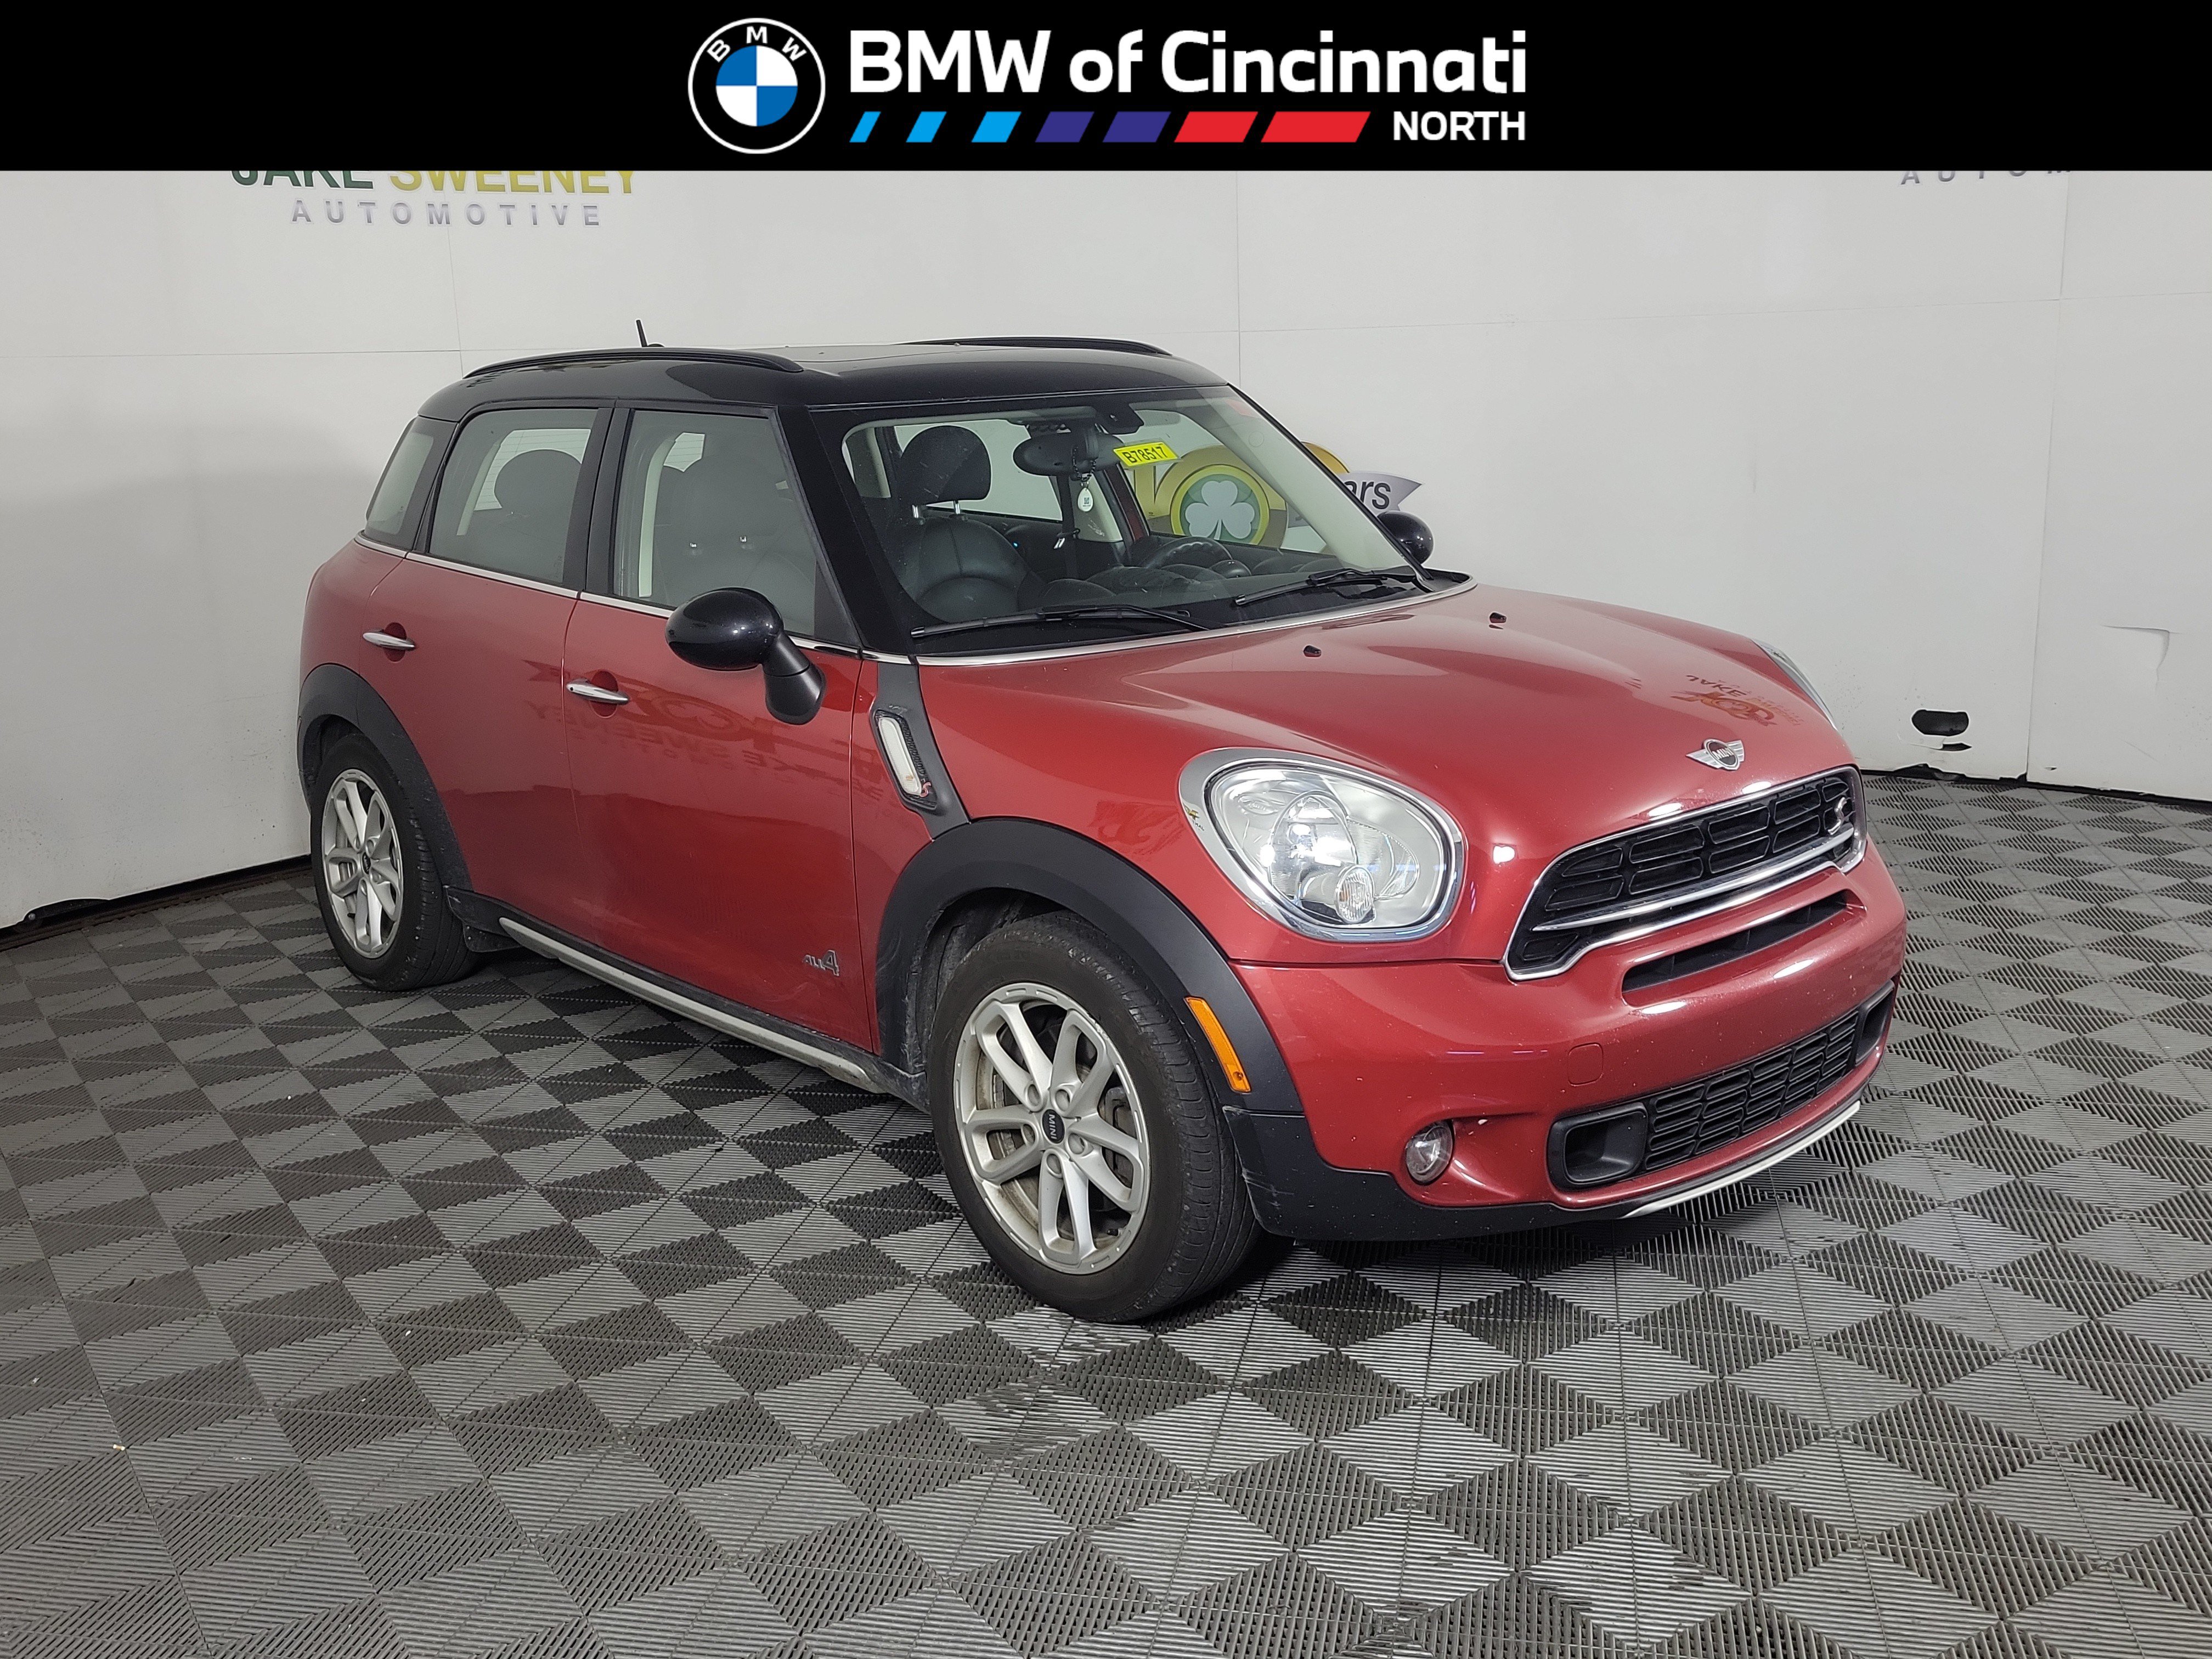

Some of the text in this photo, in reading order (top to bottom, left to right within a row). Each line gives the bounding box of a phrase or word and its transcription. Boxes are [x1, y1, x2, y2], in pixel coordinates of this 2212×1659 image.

[292, 200, 599, 226] AUTOMOTIVE
[1122, 445, 1168, 464] B78517
[1711, 747, 1735, 760] MINI
[1048, 1114, 1057, 1139] MINI
